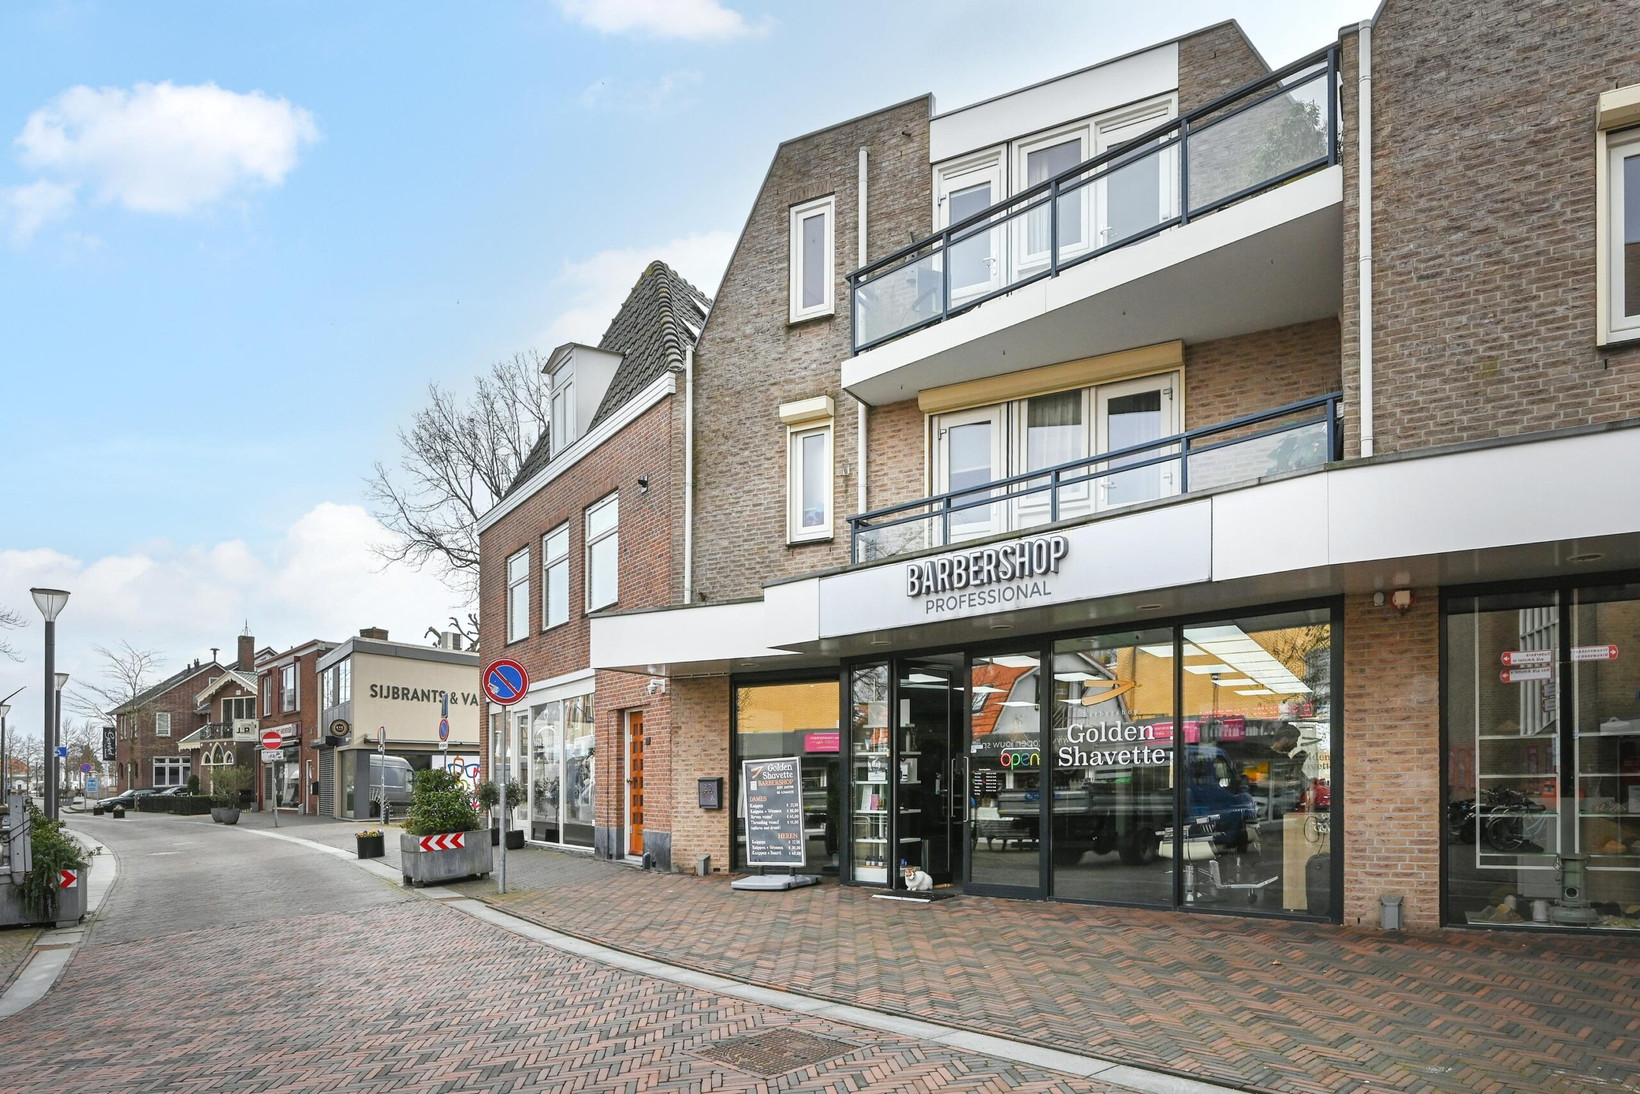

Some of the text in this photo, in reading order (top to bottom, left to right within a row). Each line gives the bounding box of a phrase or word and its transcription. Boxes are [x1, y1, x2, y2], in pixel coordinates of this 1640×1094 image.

[906, 535, 1069, 598] BARBERSHOP
[925, 580, 1052, 614] PROFESSIONAL
[369, 683, 446, 704] SIJBRANTS
[450, 692, 458, 705] &
[1067, 721, 1156, 743] Golden
[1000, 752, 1040, 770] open
[1058, 745, 1166, 766] Shavette
[762, 771, 794, 780] Shavette
[767, 763, 793, 772] Golden
